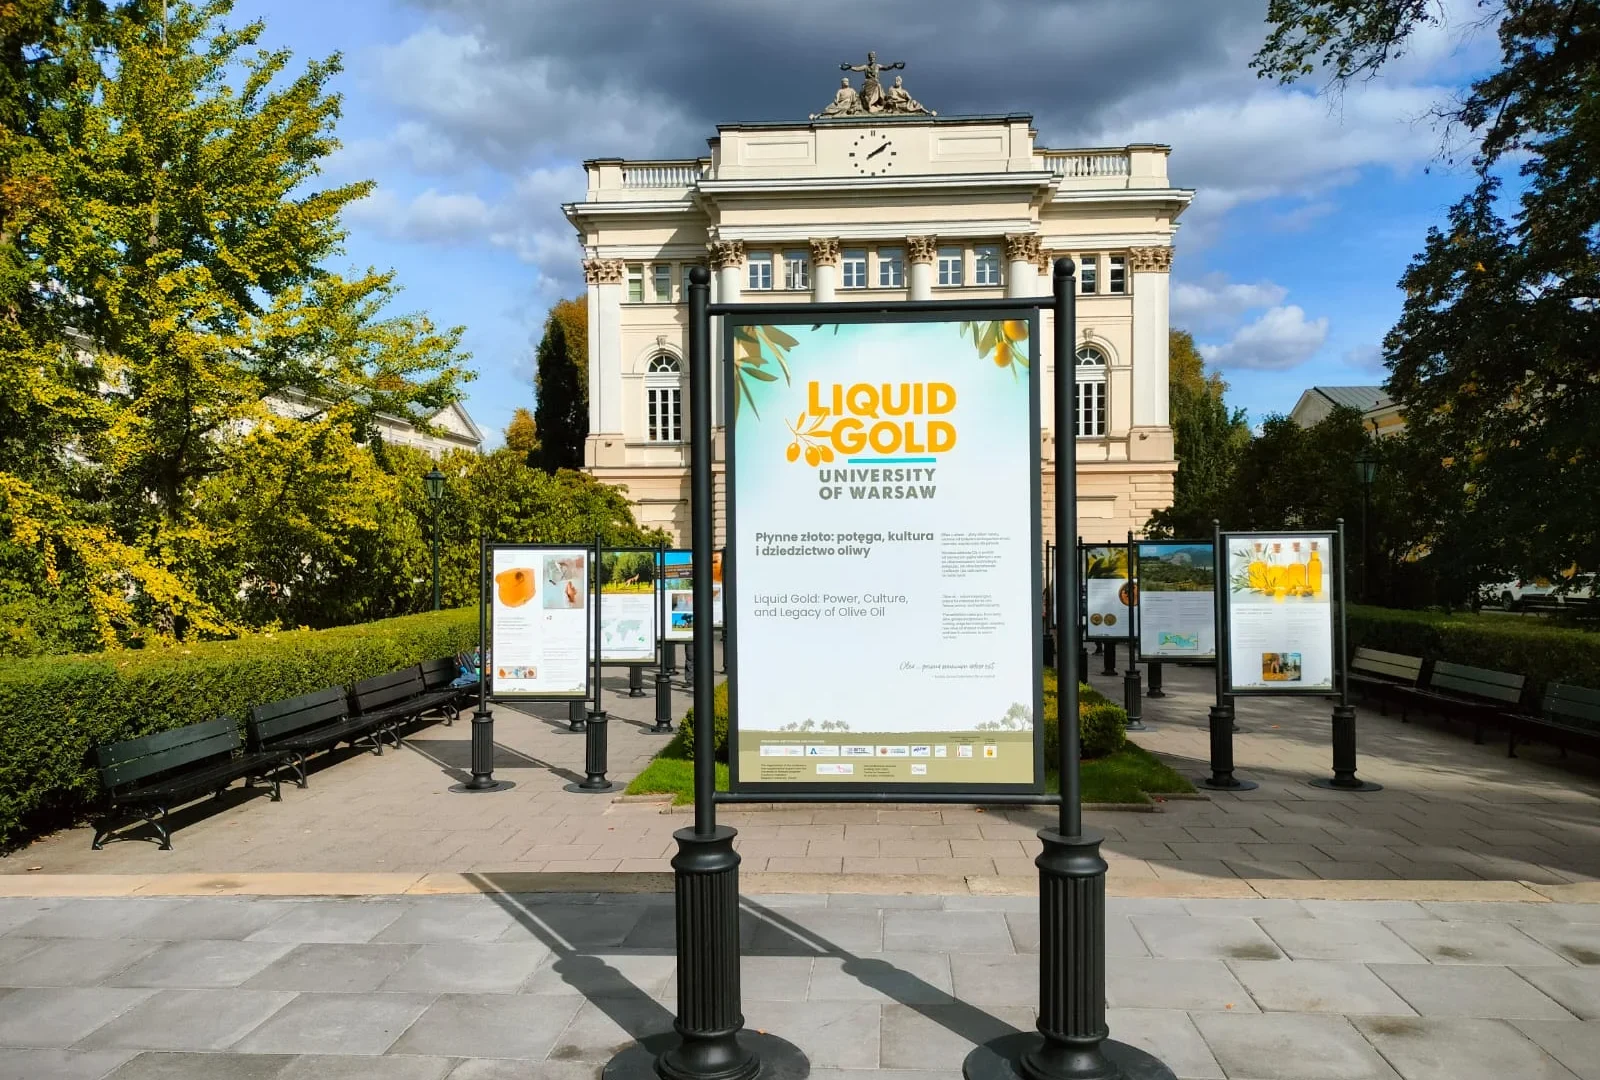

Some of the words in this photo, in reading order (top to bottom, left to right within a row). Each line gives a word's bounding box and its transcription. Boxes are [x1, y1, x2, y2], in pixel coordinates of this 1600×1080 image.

[808, 381, 956, 418] LIQUID
[830, 418, 956, 454] GOLD
[819, 468, 936, 483] UNIVERSITY
[819, 486, 842, 500] OF
[849, 486, 936, 499] WARSAW
[756, 532, 798, 545] Płynne
[801, 532, 834, 542] złoto:
[837, 532, 885, 544] potęga,
[888, 531, 934, 541] kultura
[756, 545, 759, 556] i
[762, 545, 835, 556] dziedzictwo
[837, 545, 871, 558] oliwy
[755, 594, 787, 606] Liquid
[791, 594, 820, 603] Gold:
[823, 594, 860, 604] Power,
[864, 593, 908, 604] Culture,
[754, 607, 776, 616] and
[781, 608, 821, 620] Legacy
[825, 607, 835, 616] of
[839, 607, 867, 616] Olive
[870, 607, 884, 616] Oil
